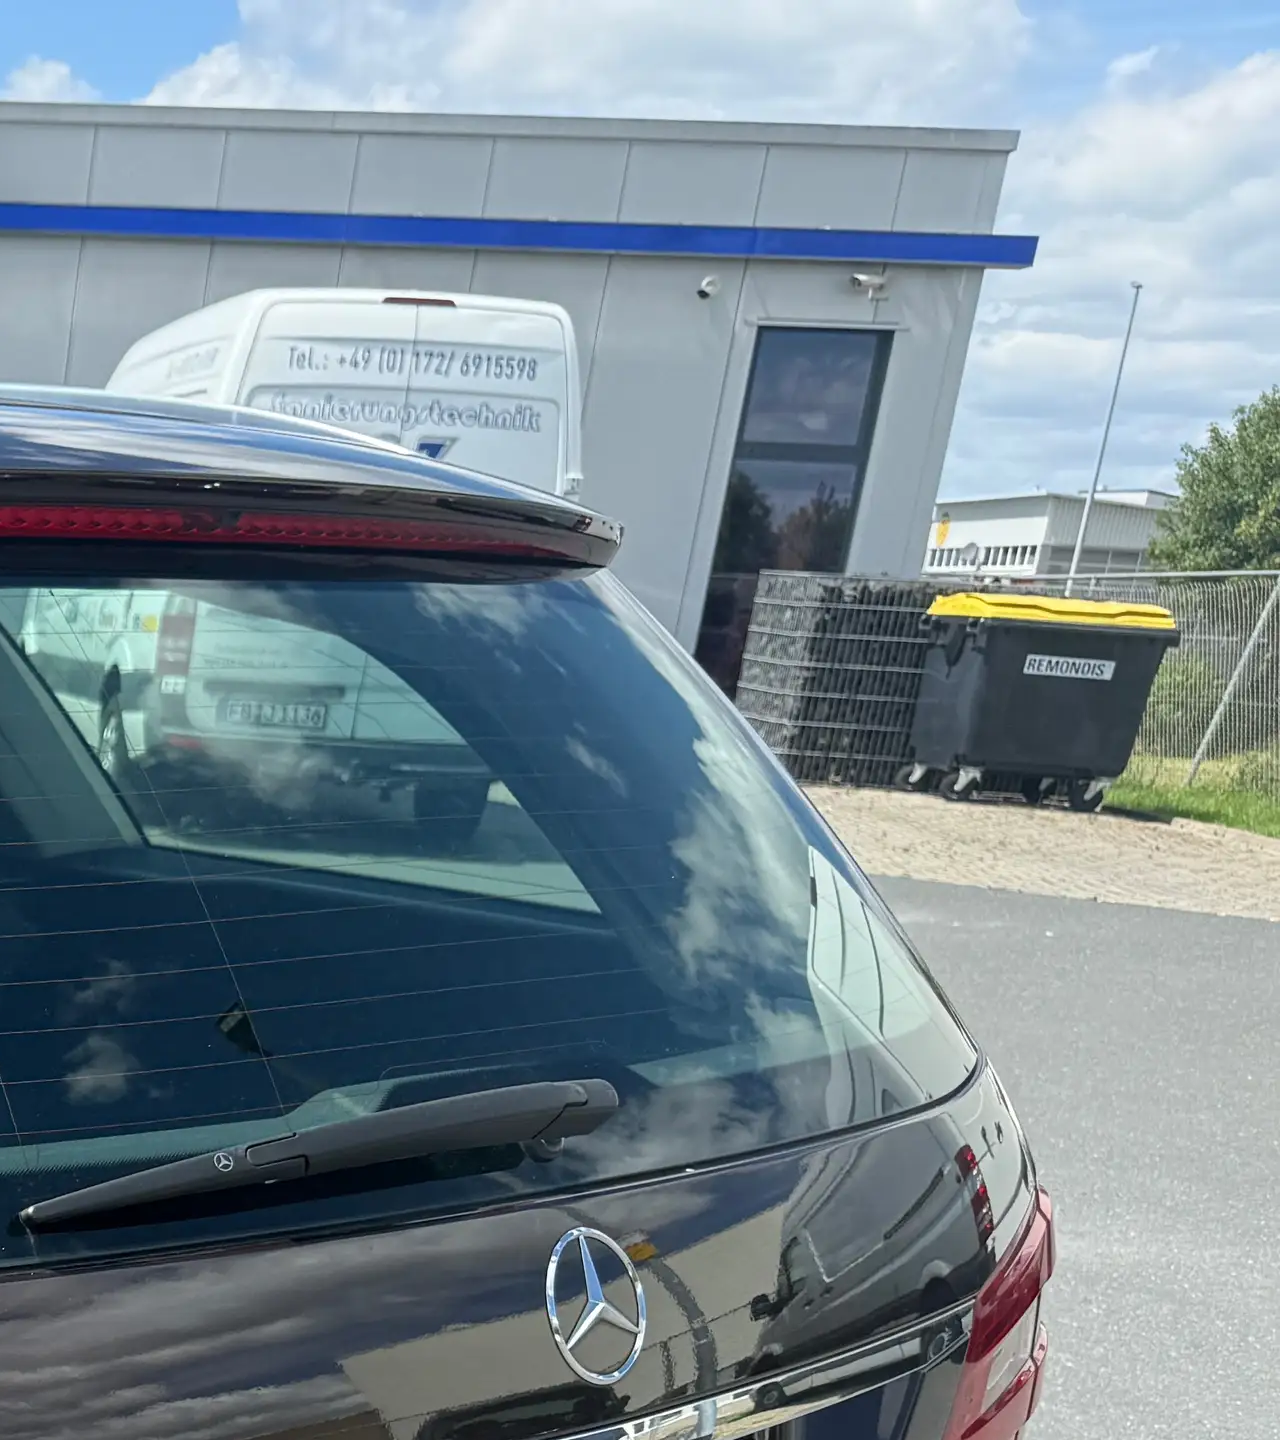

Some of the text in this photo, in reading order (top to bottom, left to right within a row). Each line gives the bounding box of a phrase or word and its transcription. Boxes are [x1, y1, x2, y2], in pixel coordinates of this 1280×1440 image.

[289, 345, 329, 371] Tel.:
[336, 348, 371, 374] +49
[459, 351, 538, 381] 6915598
[1026, 657, 1106, 677] REMONDIS
